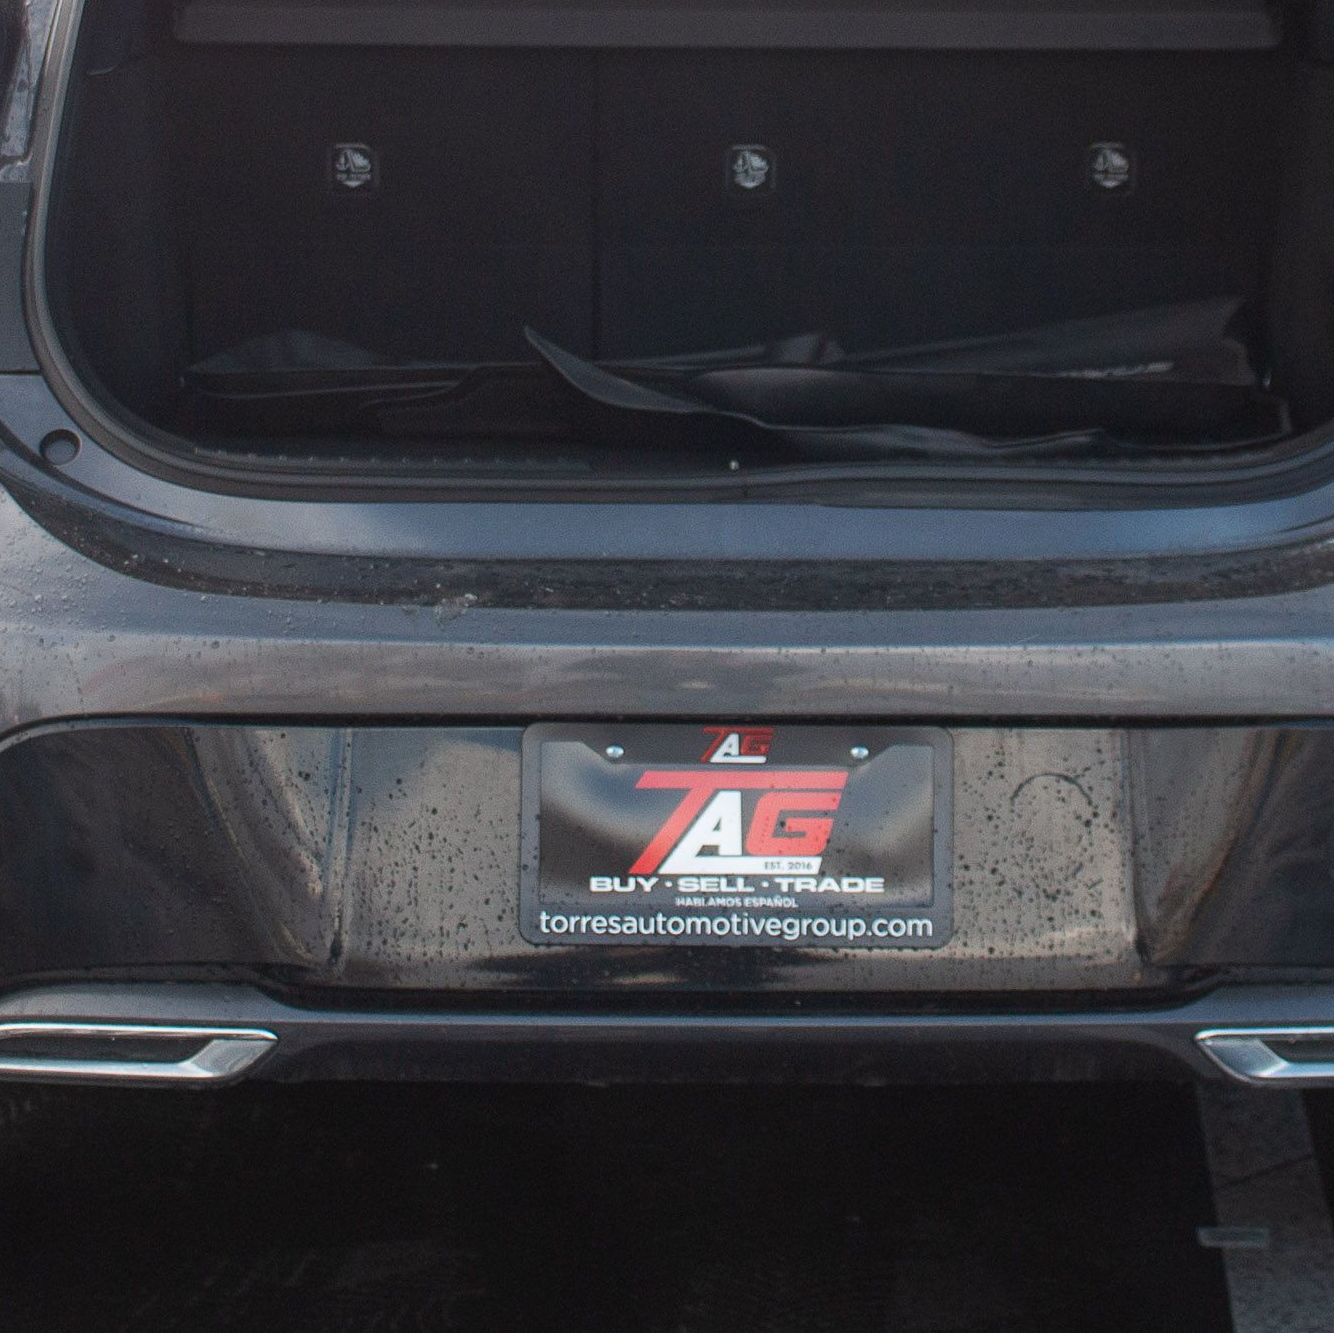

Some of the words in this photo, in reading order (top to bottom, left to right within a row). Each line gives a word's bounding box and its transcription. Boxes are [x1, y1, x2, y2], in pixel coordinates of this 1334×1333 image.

[700, 726, 773, 763] TAG
[628, 771, 849, 875] TAG
[764, 861, 785, 870] EST.
[787, 861, 813, 870] 2016
[589, 877, 659, 893] BUY
[677, 877, 755, 893] SELL
[773, 877, 885, 893] TRADE
[744, 894, 798, 908] ESPAÑOL
[539, 911, 933, 941] torresautomotivegroup.com
